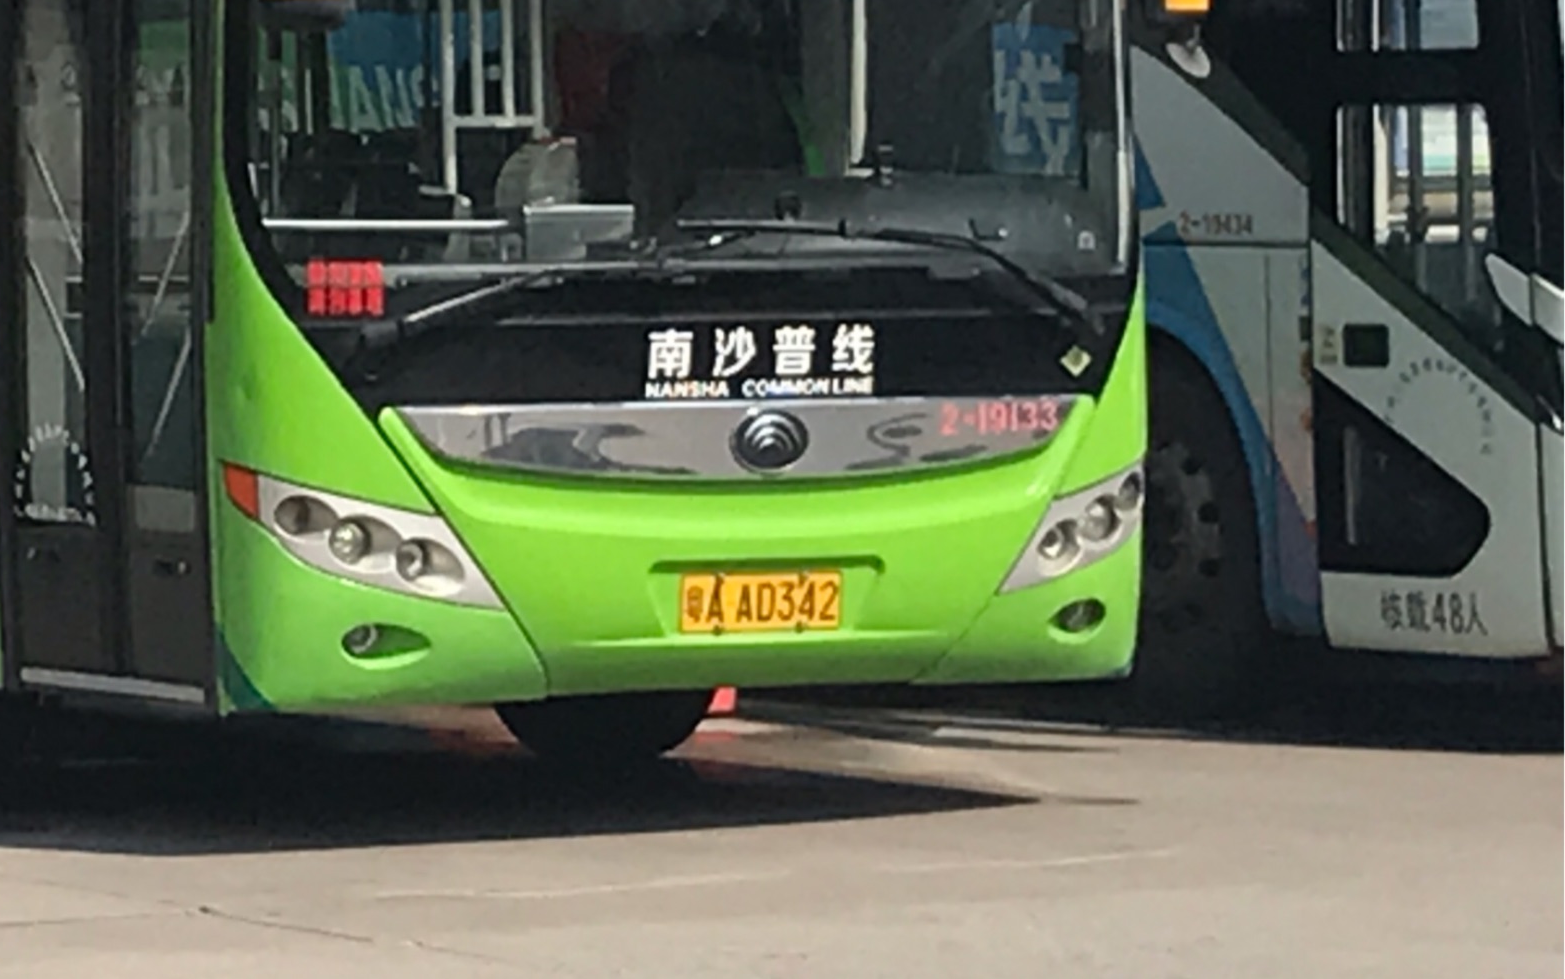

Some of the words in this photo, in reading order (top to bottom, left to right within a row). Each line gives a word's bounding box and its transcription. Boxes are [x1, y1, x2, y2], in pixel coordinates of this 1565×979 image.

[647, 323, 875, 379] 南沙普线
[644, 380, 730, 399] NANSHA
[741, 377, 831, 397] COMMON
[832, 376, 874, 396] LINE
[939, 399, 1059, 436] 2-19133
[736, 580, 839, 624] AD342
